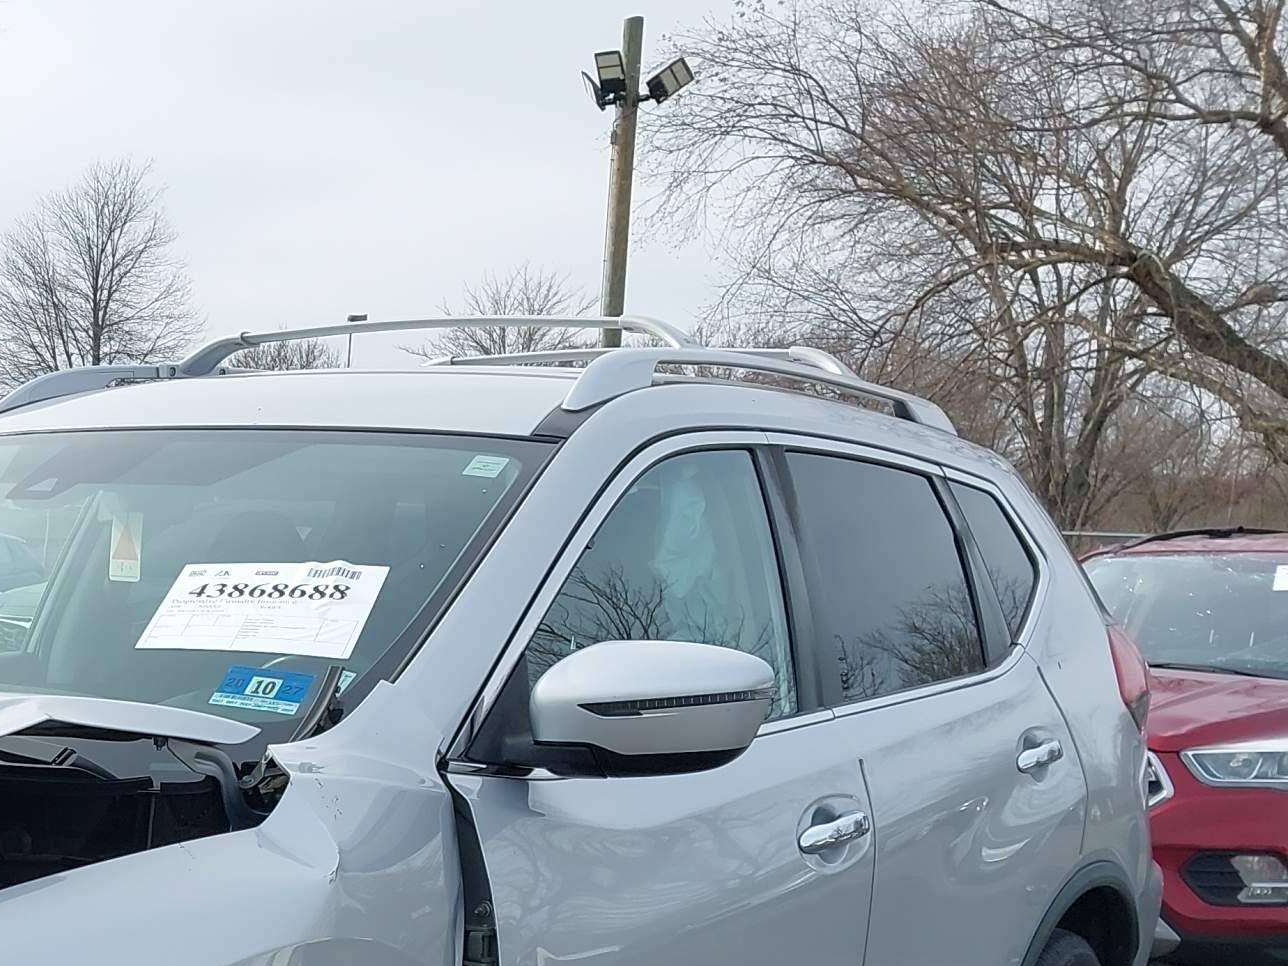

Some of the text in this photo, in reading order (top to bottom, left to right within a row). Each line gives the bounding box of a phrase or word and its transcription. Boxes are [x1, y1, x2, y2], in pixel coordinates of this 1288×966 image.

[188, 583, 351, 600] 43868688
[250, 679, 277, 695] 10
[281, 685, 304, 695] 27
